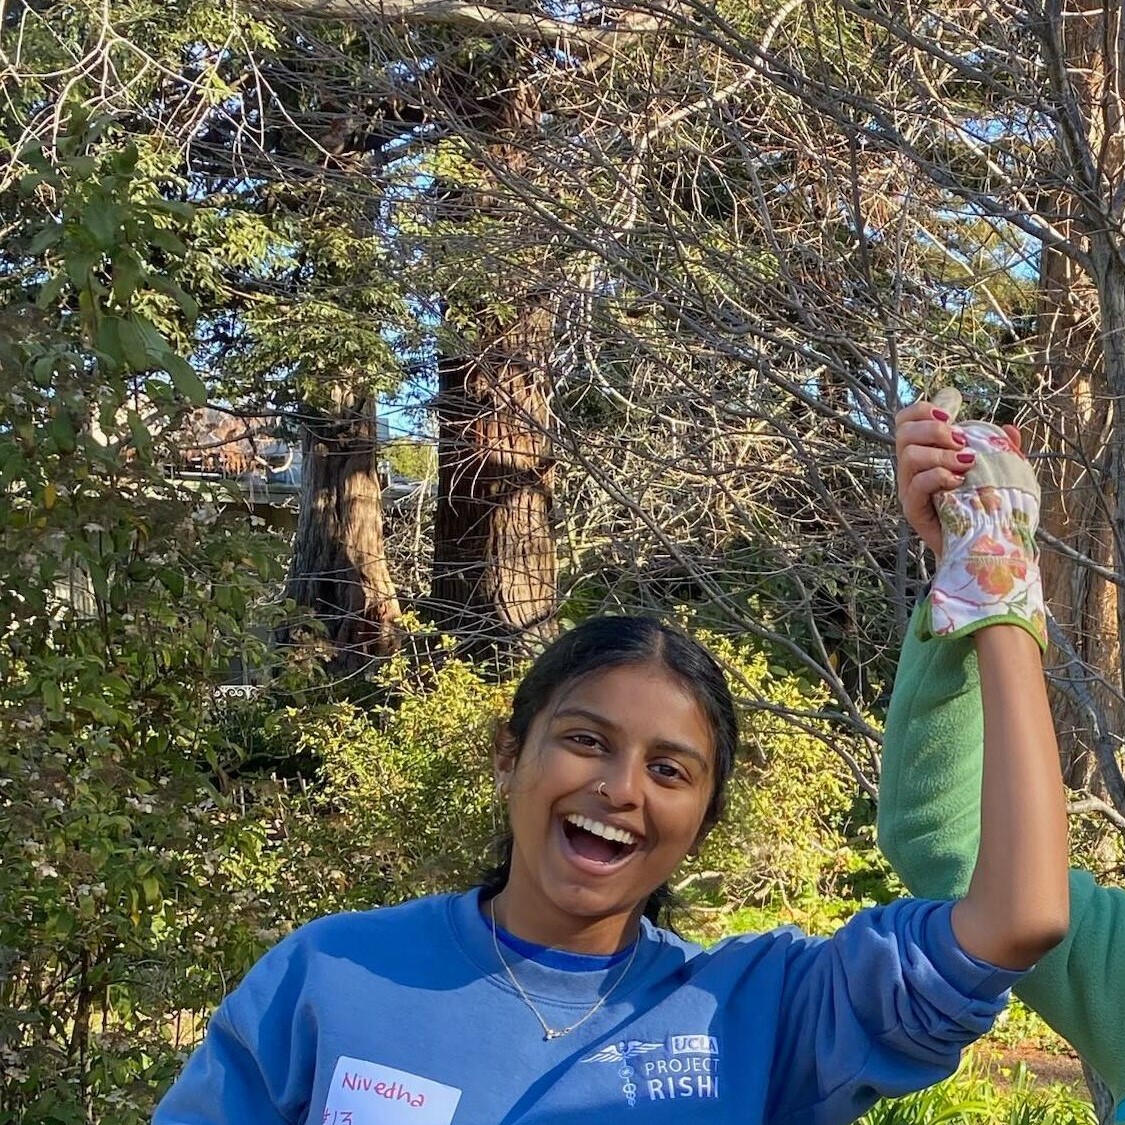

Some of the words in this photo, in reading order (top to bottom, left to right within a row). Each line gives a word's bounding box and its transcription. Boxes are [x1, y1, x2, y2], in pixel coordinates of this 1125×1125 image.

[673, 1036, 718, 1053] UCLA
[645, 1057, 720, 1076] PROJECT
[342, 1071, 425, 1108] Nivedha
[648, 1075, 719, 1101] RISHI
